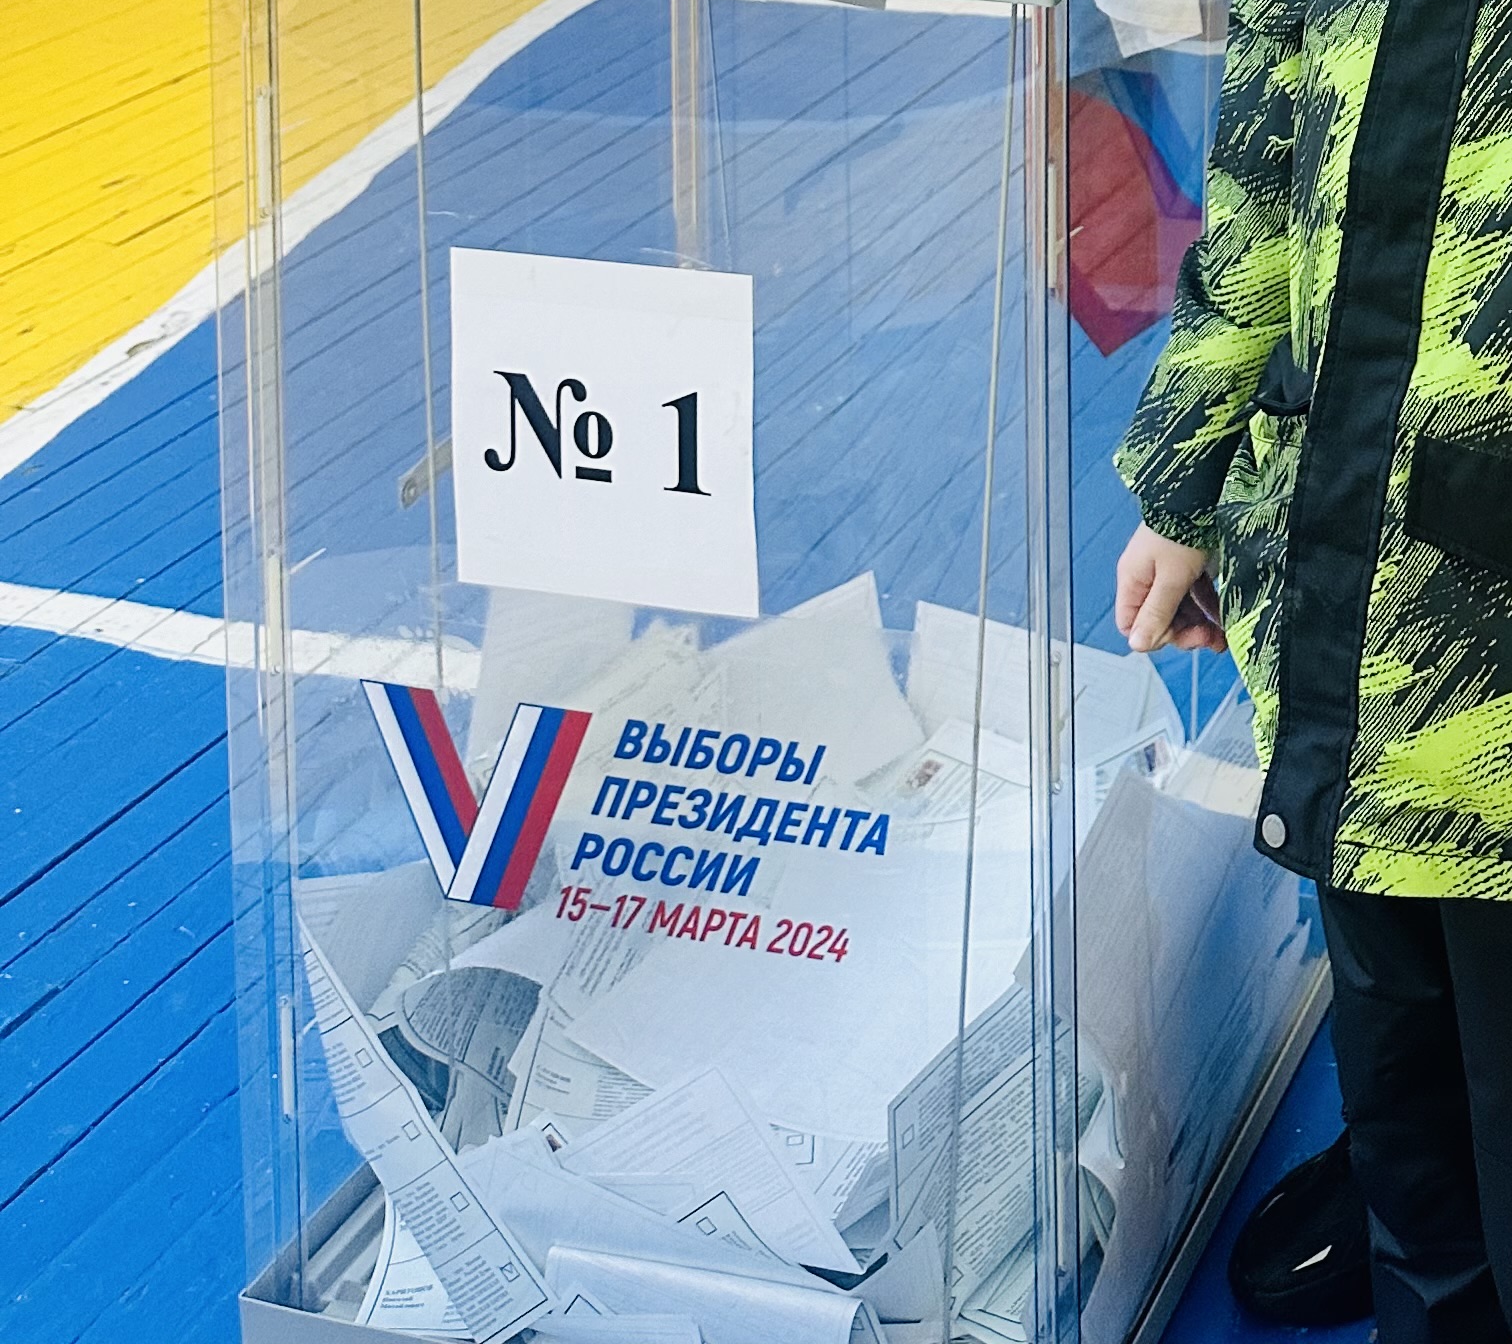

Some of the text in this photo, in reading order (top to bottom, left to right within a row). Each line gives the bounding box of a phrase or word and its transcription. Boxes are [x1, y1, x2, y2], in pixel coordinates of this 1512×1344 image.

[484, 370, 712, 497] № 1
[614, 719, 826, 785] ВЫБОРЫ
[591, 776, 890, 856] ПРЕЗИДЕНТА
[570, 832, 760, 897] РОССИИ
[648, 899, 761, 950] МАРТА
[766, 918, 850, 963] 2024
